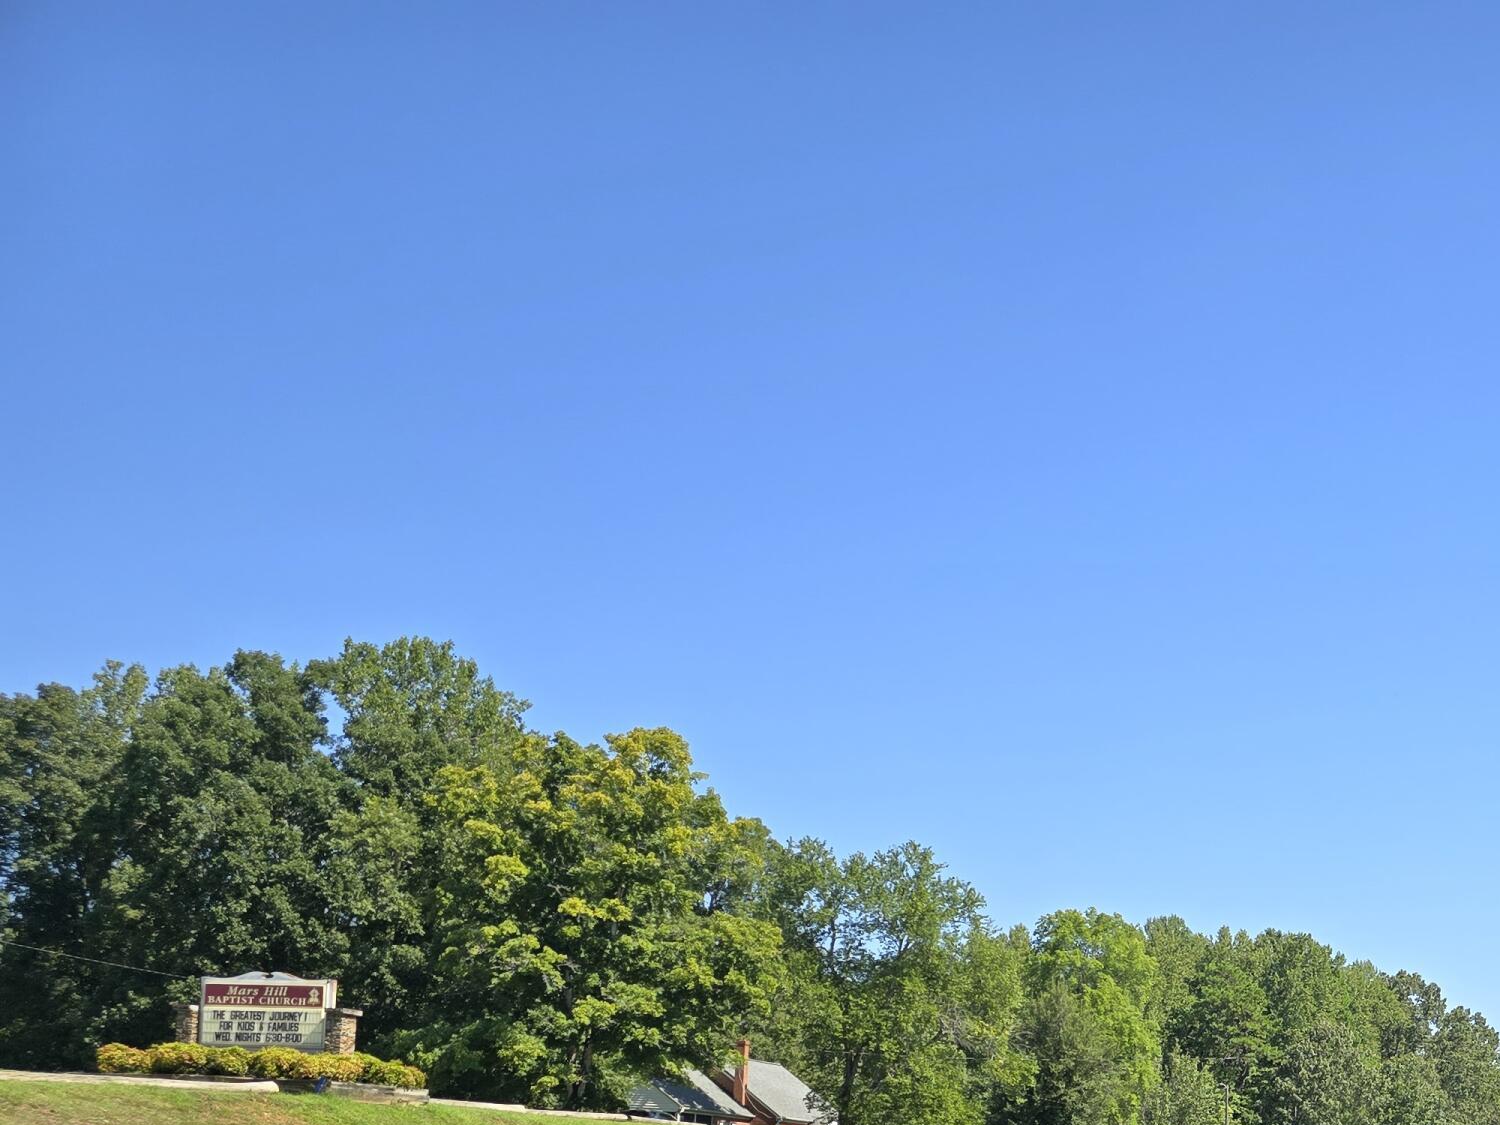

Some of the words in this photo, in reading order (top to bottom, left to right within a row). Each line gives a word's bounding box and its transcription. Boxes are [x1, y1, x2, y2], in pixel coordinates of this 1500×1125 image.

[226, 986, 259, 996] Mars
[264, 986, 288, 997] Hill
[207, 995, 254, 1004] BAPTIST
[259, 996, 306, 1006] CHURCH
[213, 1010, 225, 1020] THE
[230, 1011, 265, 1021] GREATEST
[219, 1021, 233, 1031] FOR
[237, 1022, 255, 1031] KIDS
[267, 1022, 299, 1032] FAMILIES
[214, 1032, 232, 1041] WED.
[235, 1032, 261, 1042] NIGHTS
